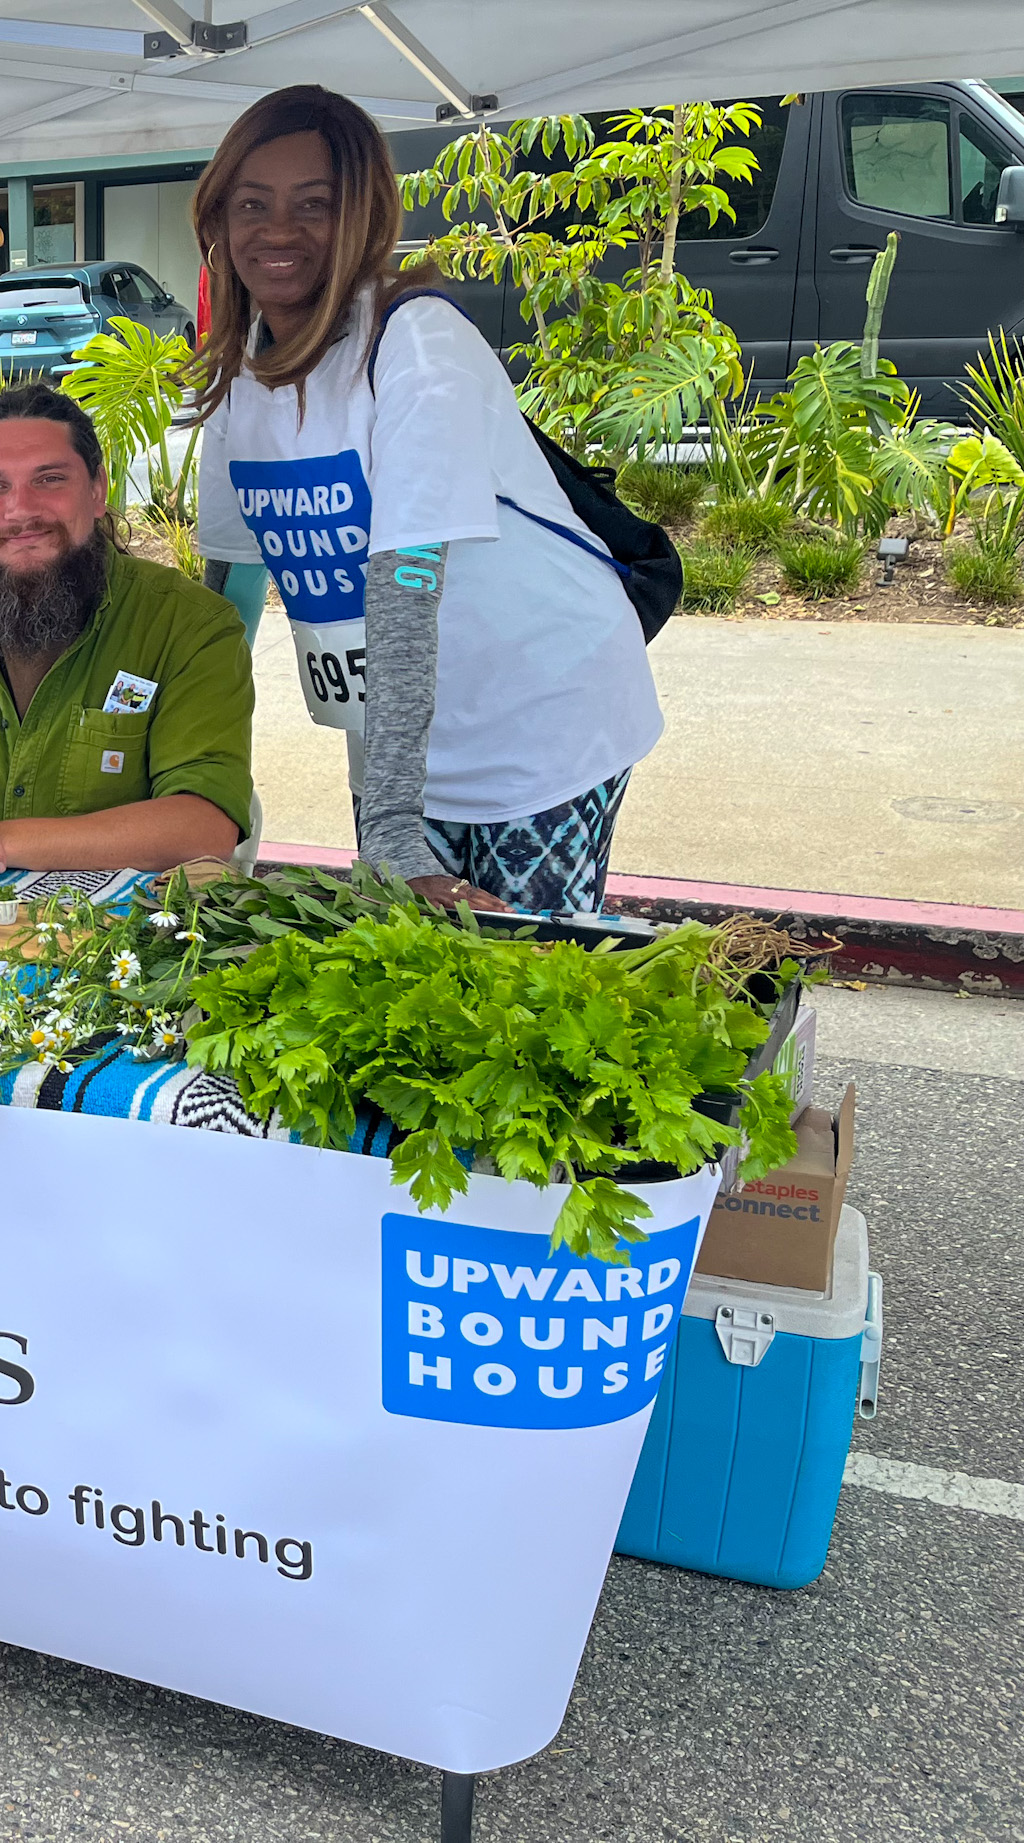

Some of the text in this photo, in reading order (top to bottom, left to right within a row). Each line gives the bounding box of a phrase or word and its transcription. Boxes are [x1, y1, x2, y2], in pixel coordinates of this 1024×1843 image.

[237, 482, 354, 518] UPWARD
[262, 524, 369, 558] OUND
[280, 561, 369, 597] OUS
[306, 648, 367, 703] 695
[743, 1180, 820, 1201] Staples
[405, 1248, 681, 1303] UPWARD
[407, 1300, 674, 1352] BOUND
[408, 1343, 666, 1399] HOUSE
[68, 1484, 314, 1581] fighting
